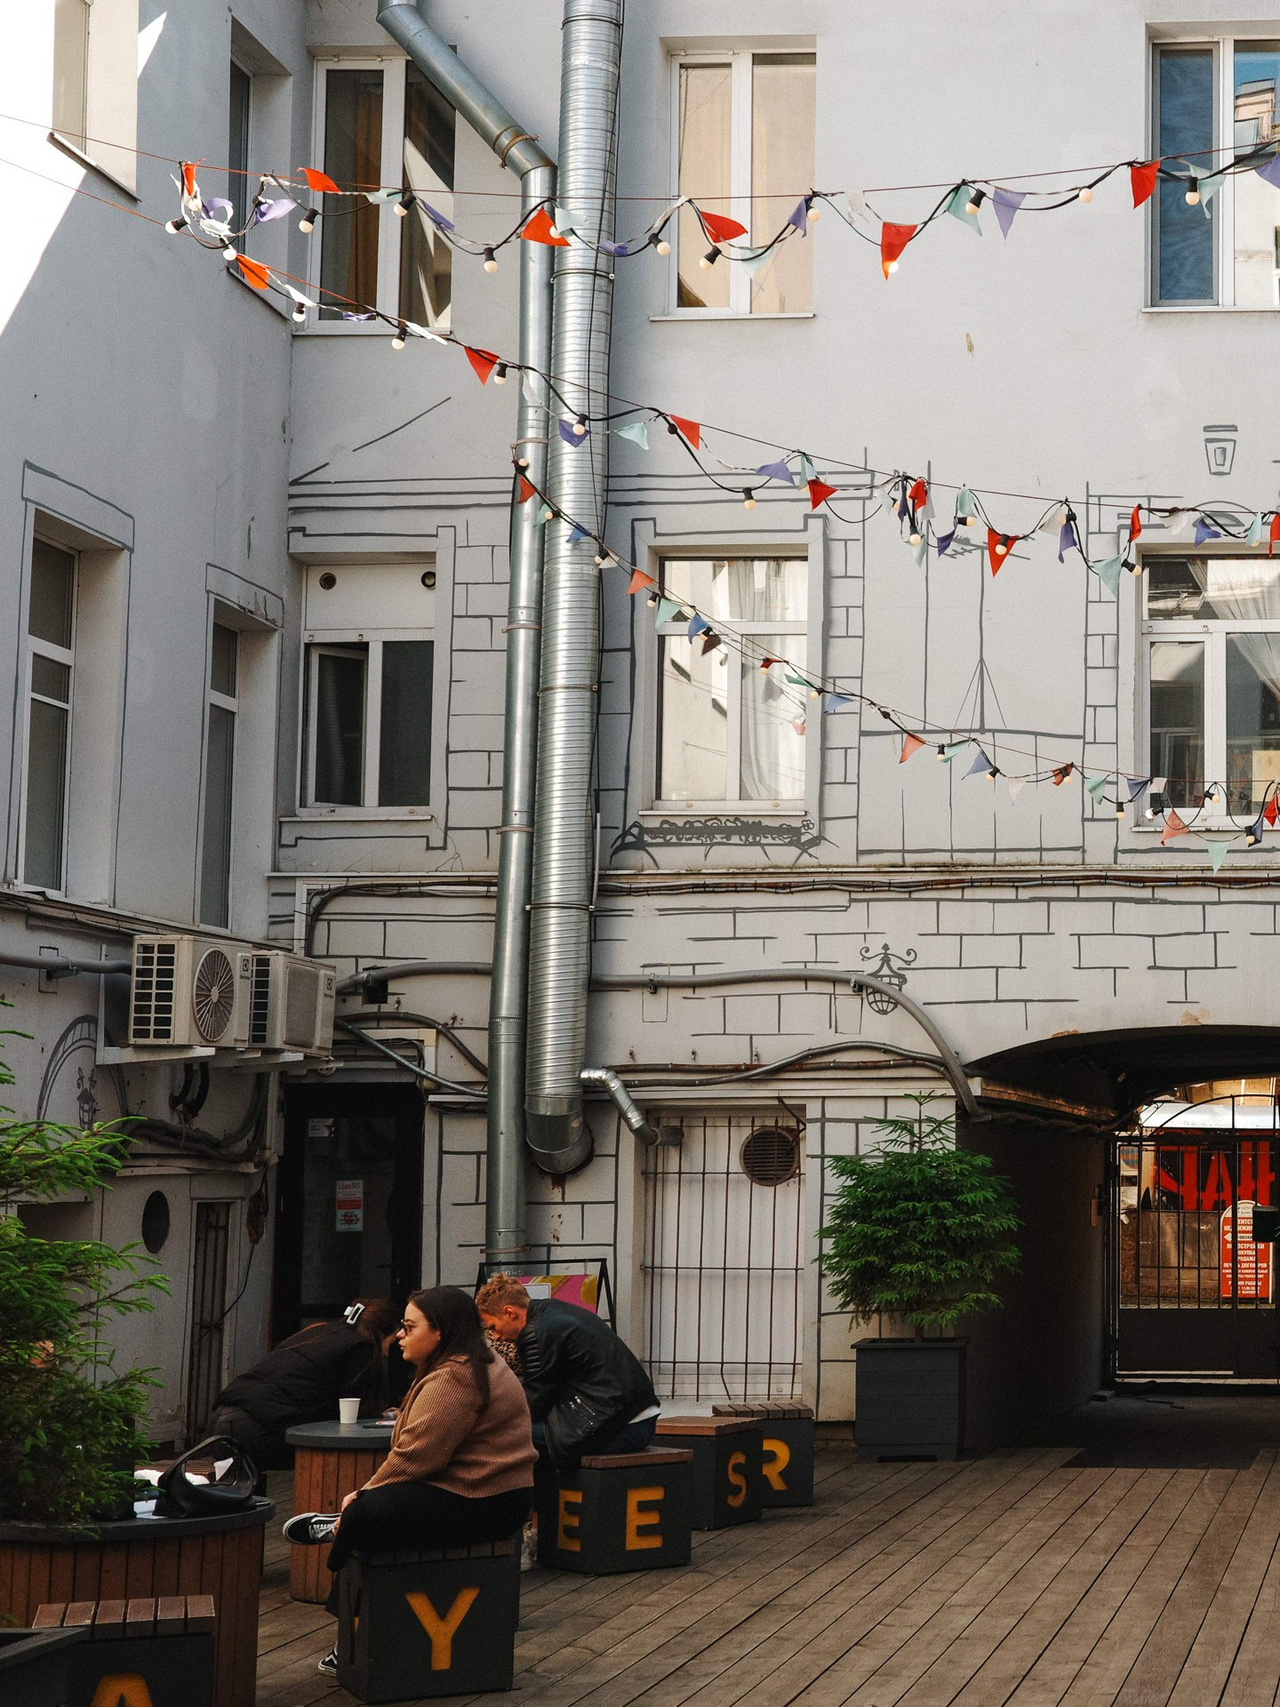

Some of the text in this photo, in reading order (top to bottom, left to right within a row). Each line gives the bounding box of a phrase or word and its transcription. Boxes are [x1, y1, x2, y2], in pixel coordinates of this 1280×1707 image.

[727, 1451, 747, 1507] S
[762, 1438, 790, 1491] R
[557, 1489, 583, 1552] E
[625, 1486, 665, 1550] E
[405, 1585, 482, 1670] Y
